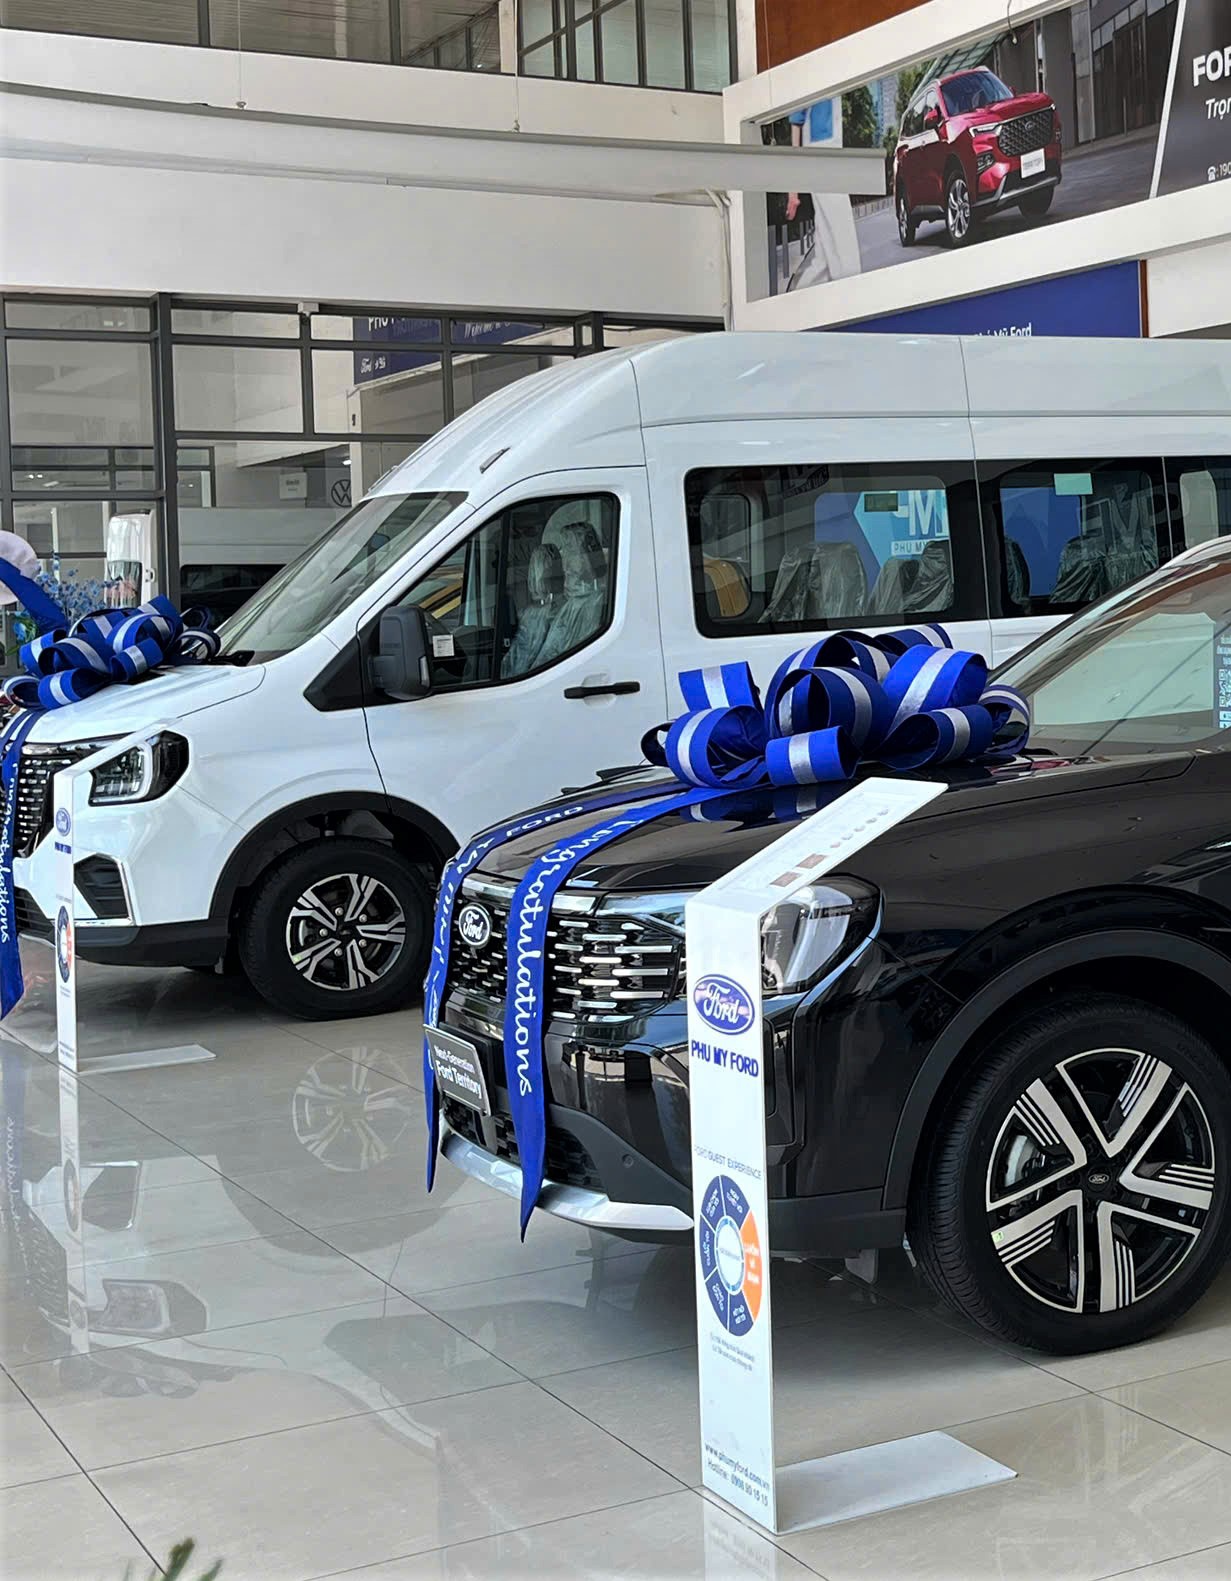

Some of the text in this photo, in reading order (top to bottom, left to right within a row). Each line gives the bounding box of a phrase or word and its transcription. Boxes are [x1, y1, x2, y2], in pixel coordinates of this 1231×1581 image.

[1009, 322, 1032, 337] Ford
[506, 805, 584, 838] FORD
[703, 982, 741, 1025] Ford
[691, 1040, 759, 1078] PHU MY FORD
[435, 1060, 454, 1083] Ford
[451, 1066, 482, 1100] Territory
